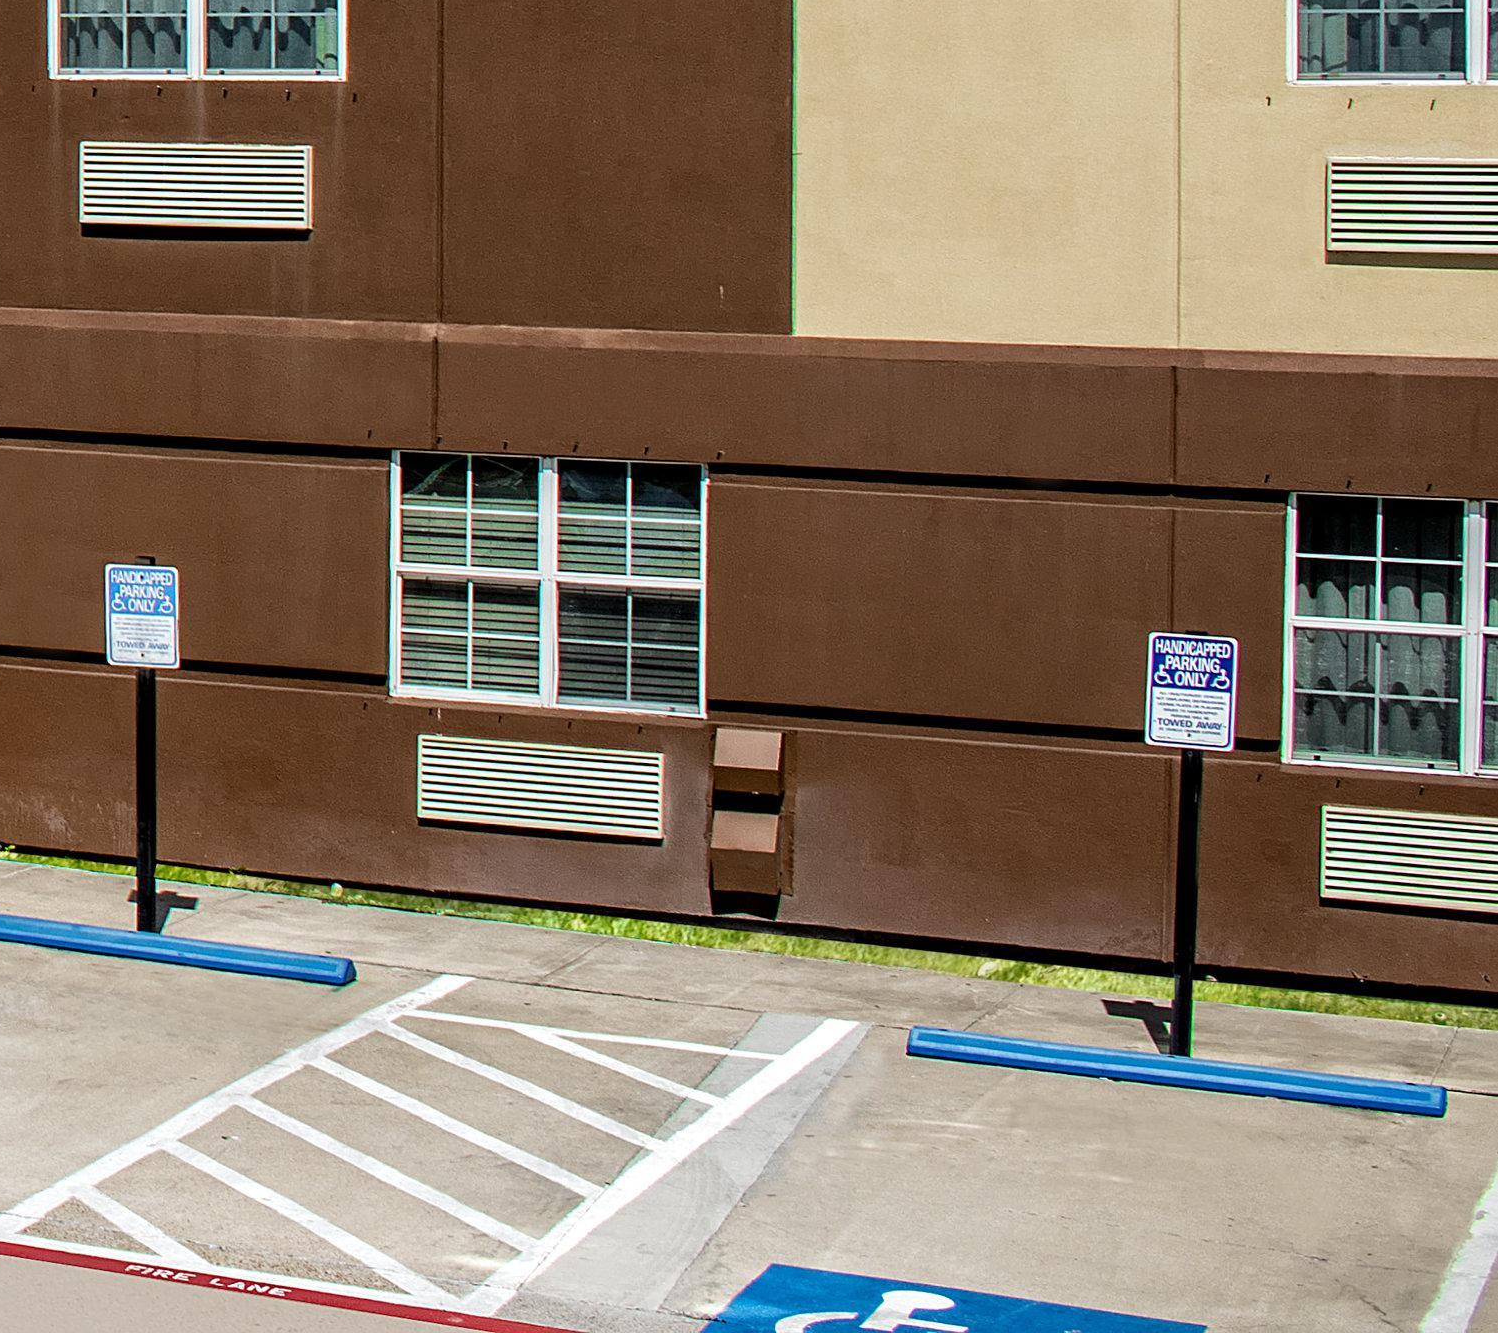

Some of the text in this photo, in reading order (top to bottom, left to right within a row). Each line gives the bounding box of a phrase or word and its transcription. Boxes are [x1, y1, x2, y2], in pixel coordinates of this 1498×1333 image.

[111, 570, 173, 586] HANDICAPPED
[119, 584, 164, 599] PARKING
[128, 599, 156, 613] ONLY
[1155, 638, 1231, 658] HANDICAPPED
[1165, 654, 1220, 674] PARKING
[1174, 670, 1211, 688] ONLY
[124, 1264, 292, 1296] FIRE LANE
